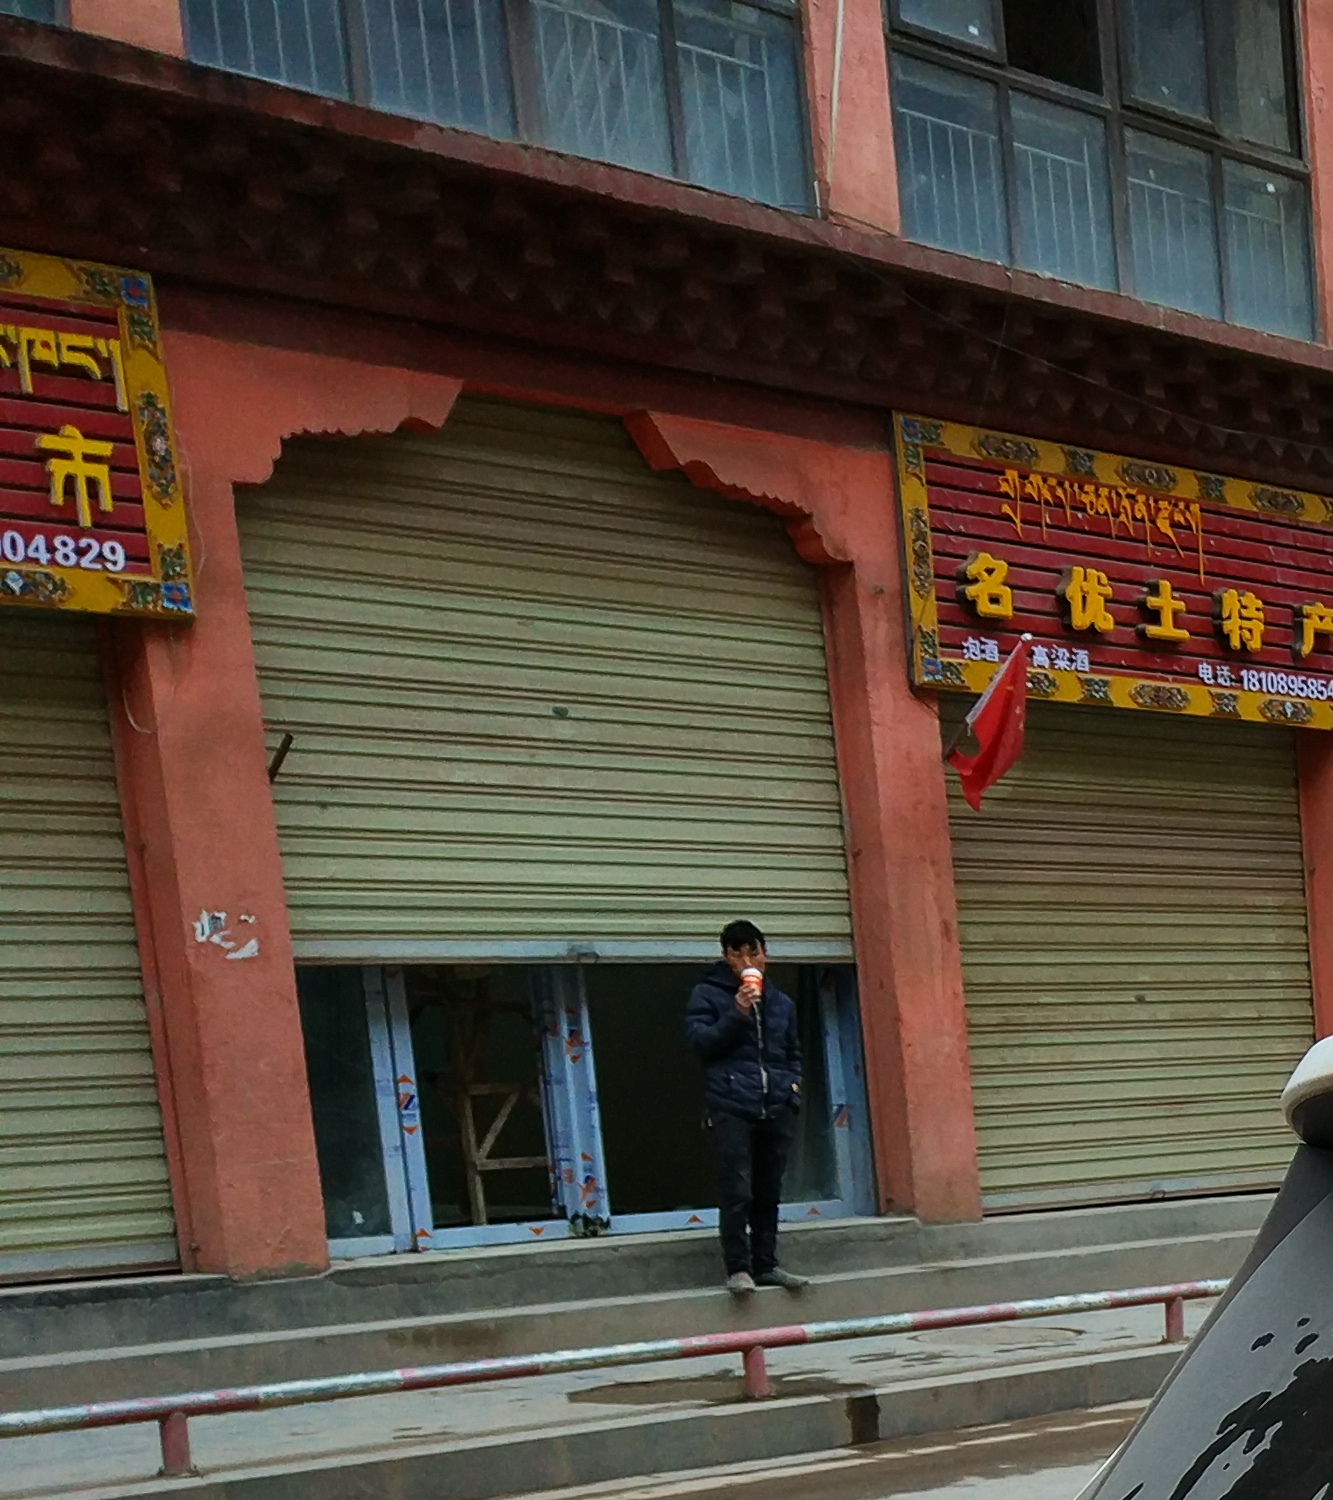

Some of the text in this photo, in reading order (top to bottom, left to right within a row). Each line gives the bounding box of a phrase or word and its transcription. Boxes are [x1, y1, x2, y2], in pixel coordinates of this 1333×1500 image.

[36, 424, 115, 528] 市
[2, 529, 126, 572] 04829
[961, 636, 999, 662] 泡酒
